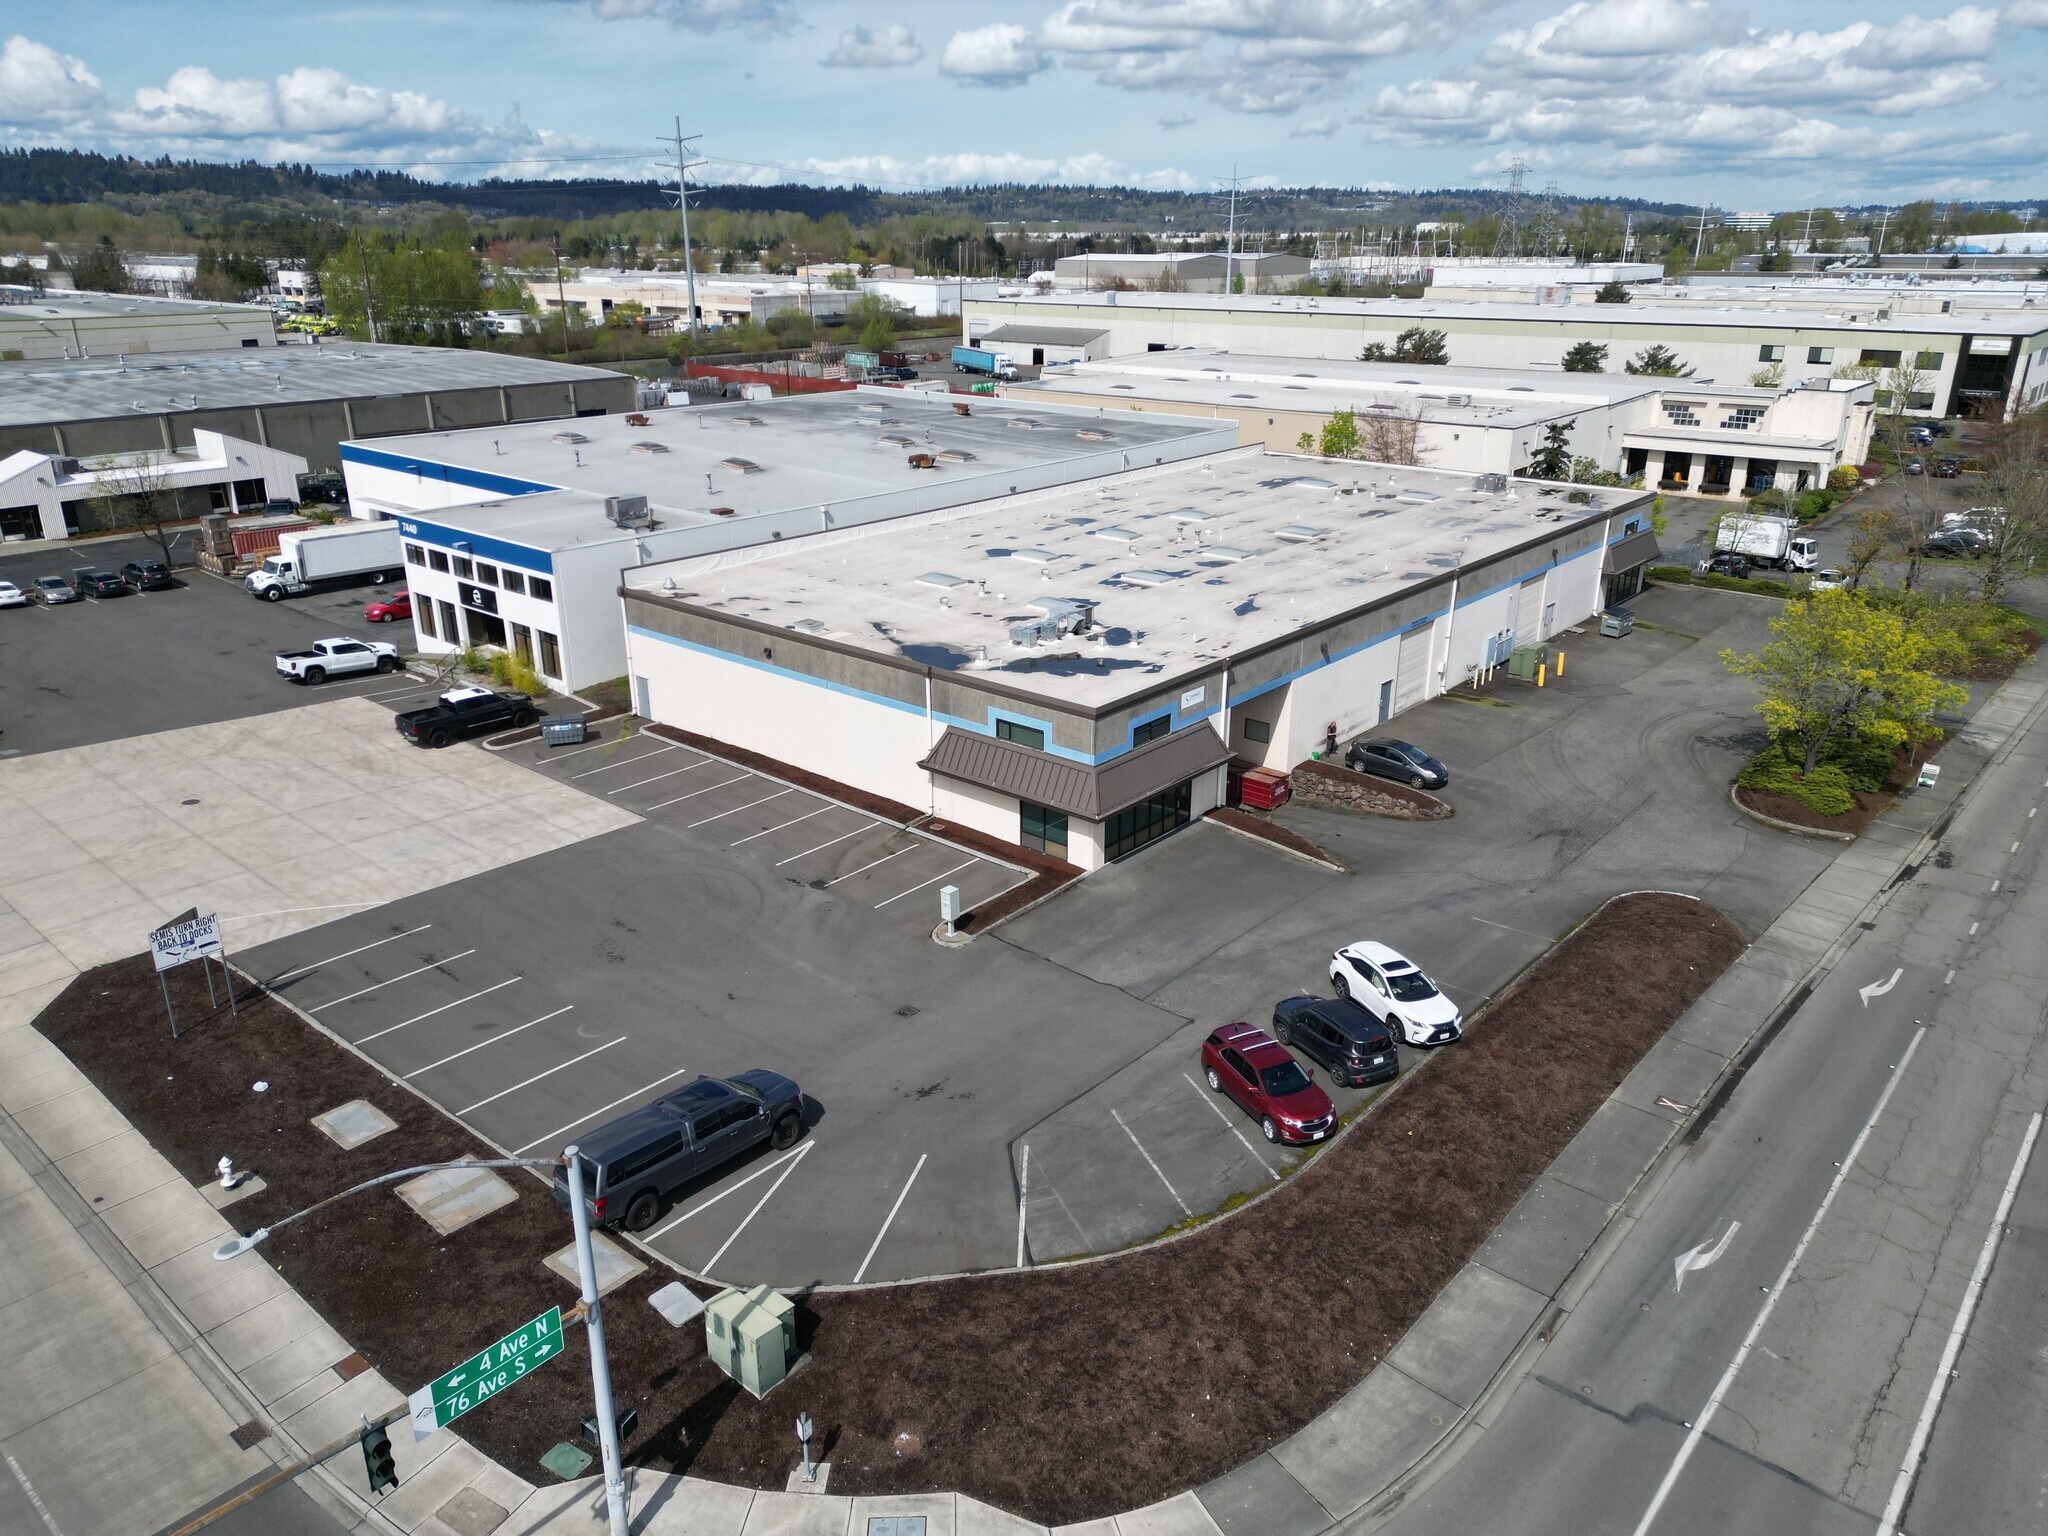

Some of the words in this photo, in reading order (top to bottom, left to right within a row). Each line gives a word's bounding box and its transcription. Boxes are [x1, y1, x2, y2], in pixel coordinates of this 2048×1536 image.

[402, 522, 417, 534] 7440
[150, 929, 173, 943] SEMIS
[175, 922, 193, 934] TURN
[195, 915, 216, 928] RIGHT
[158, 937, 177, 950] BACK
[178, 933, 187, 943] TO
[189, 925, 212, 940] DOCKS
[479, 1352, 492, 1372] 4
[499, 1333, 528, 1362] Ave
[535, 1317, 548, 1339] N
[446, 1392, 470, 1417] 76
[477, 1371, 508, 1400] Ave
[514, 1356, 526, 1375] S
